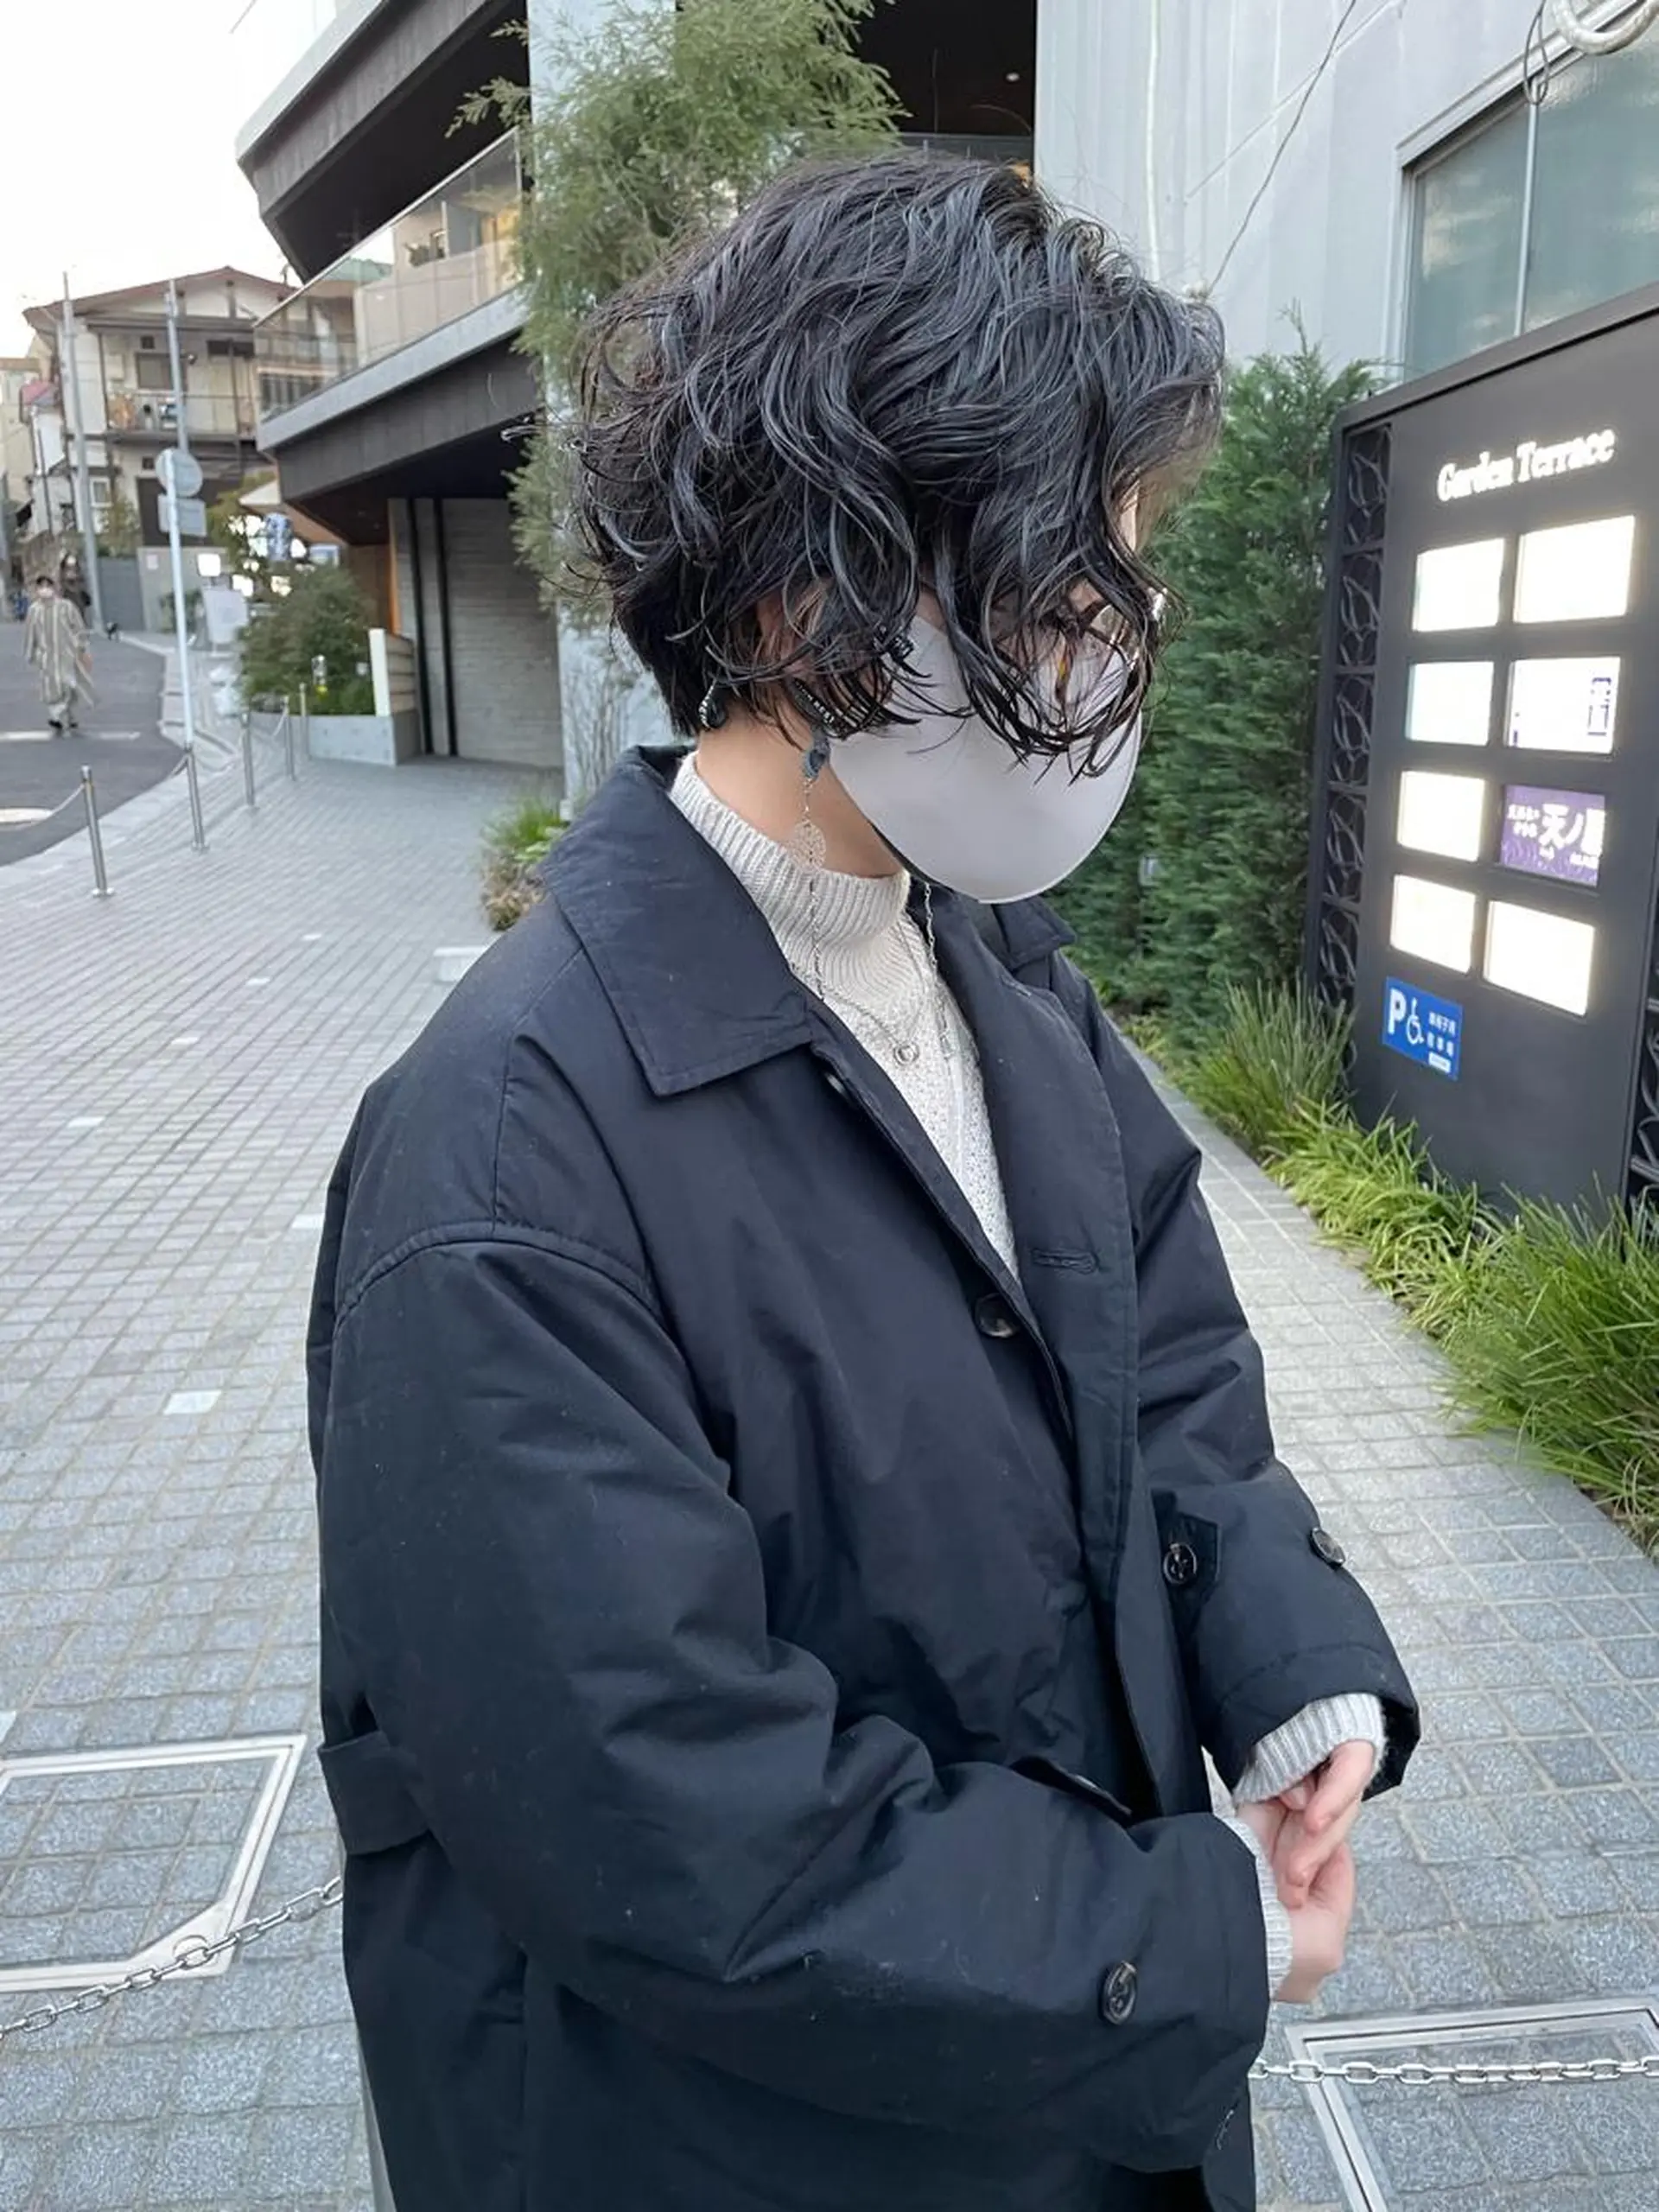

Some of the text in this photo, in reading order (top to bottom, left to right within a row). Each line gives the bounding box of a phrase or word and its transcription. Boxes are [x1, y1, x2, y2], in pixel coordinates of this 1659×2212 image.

[1438, 429, 1615, 501] Garden Terrace
[1388, 987, 1407, 1035] P
